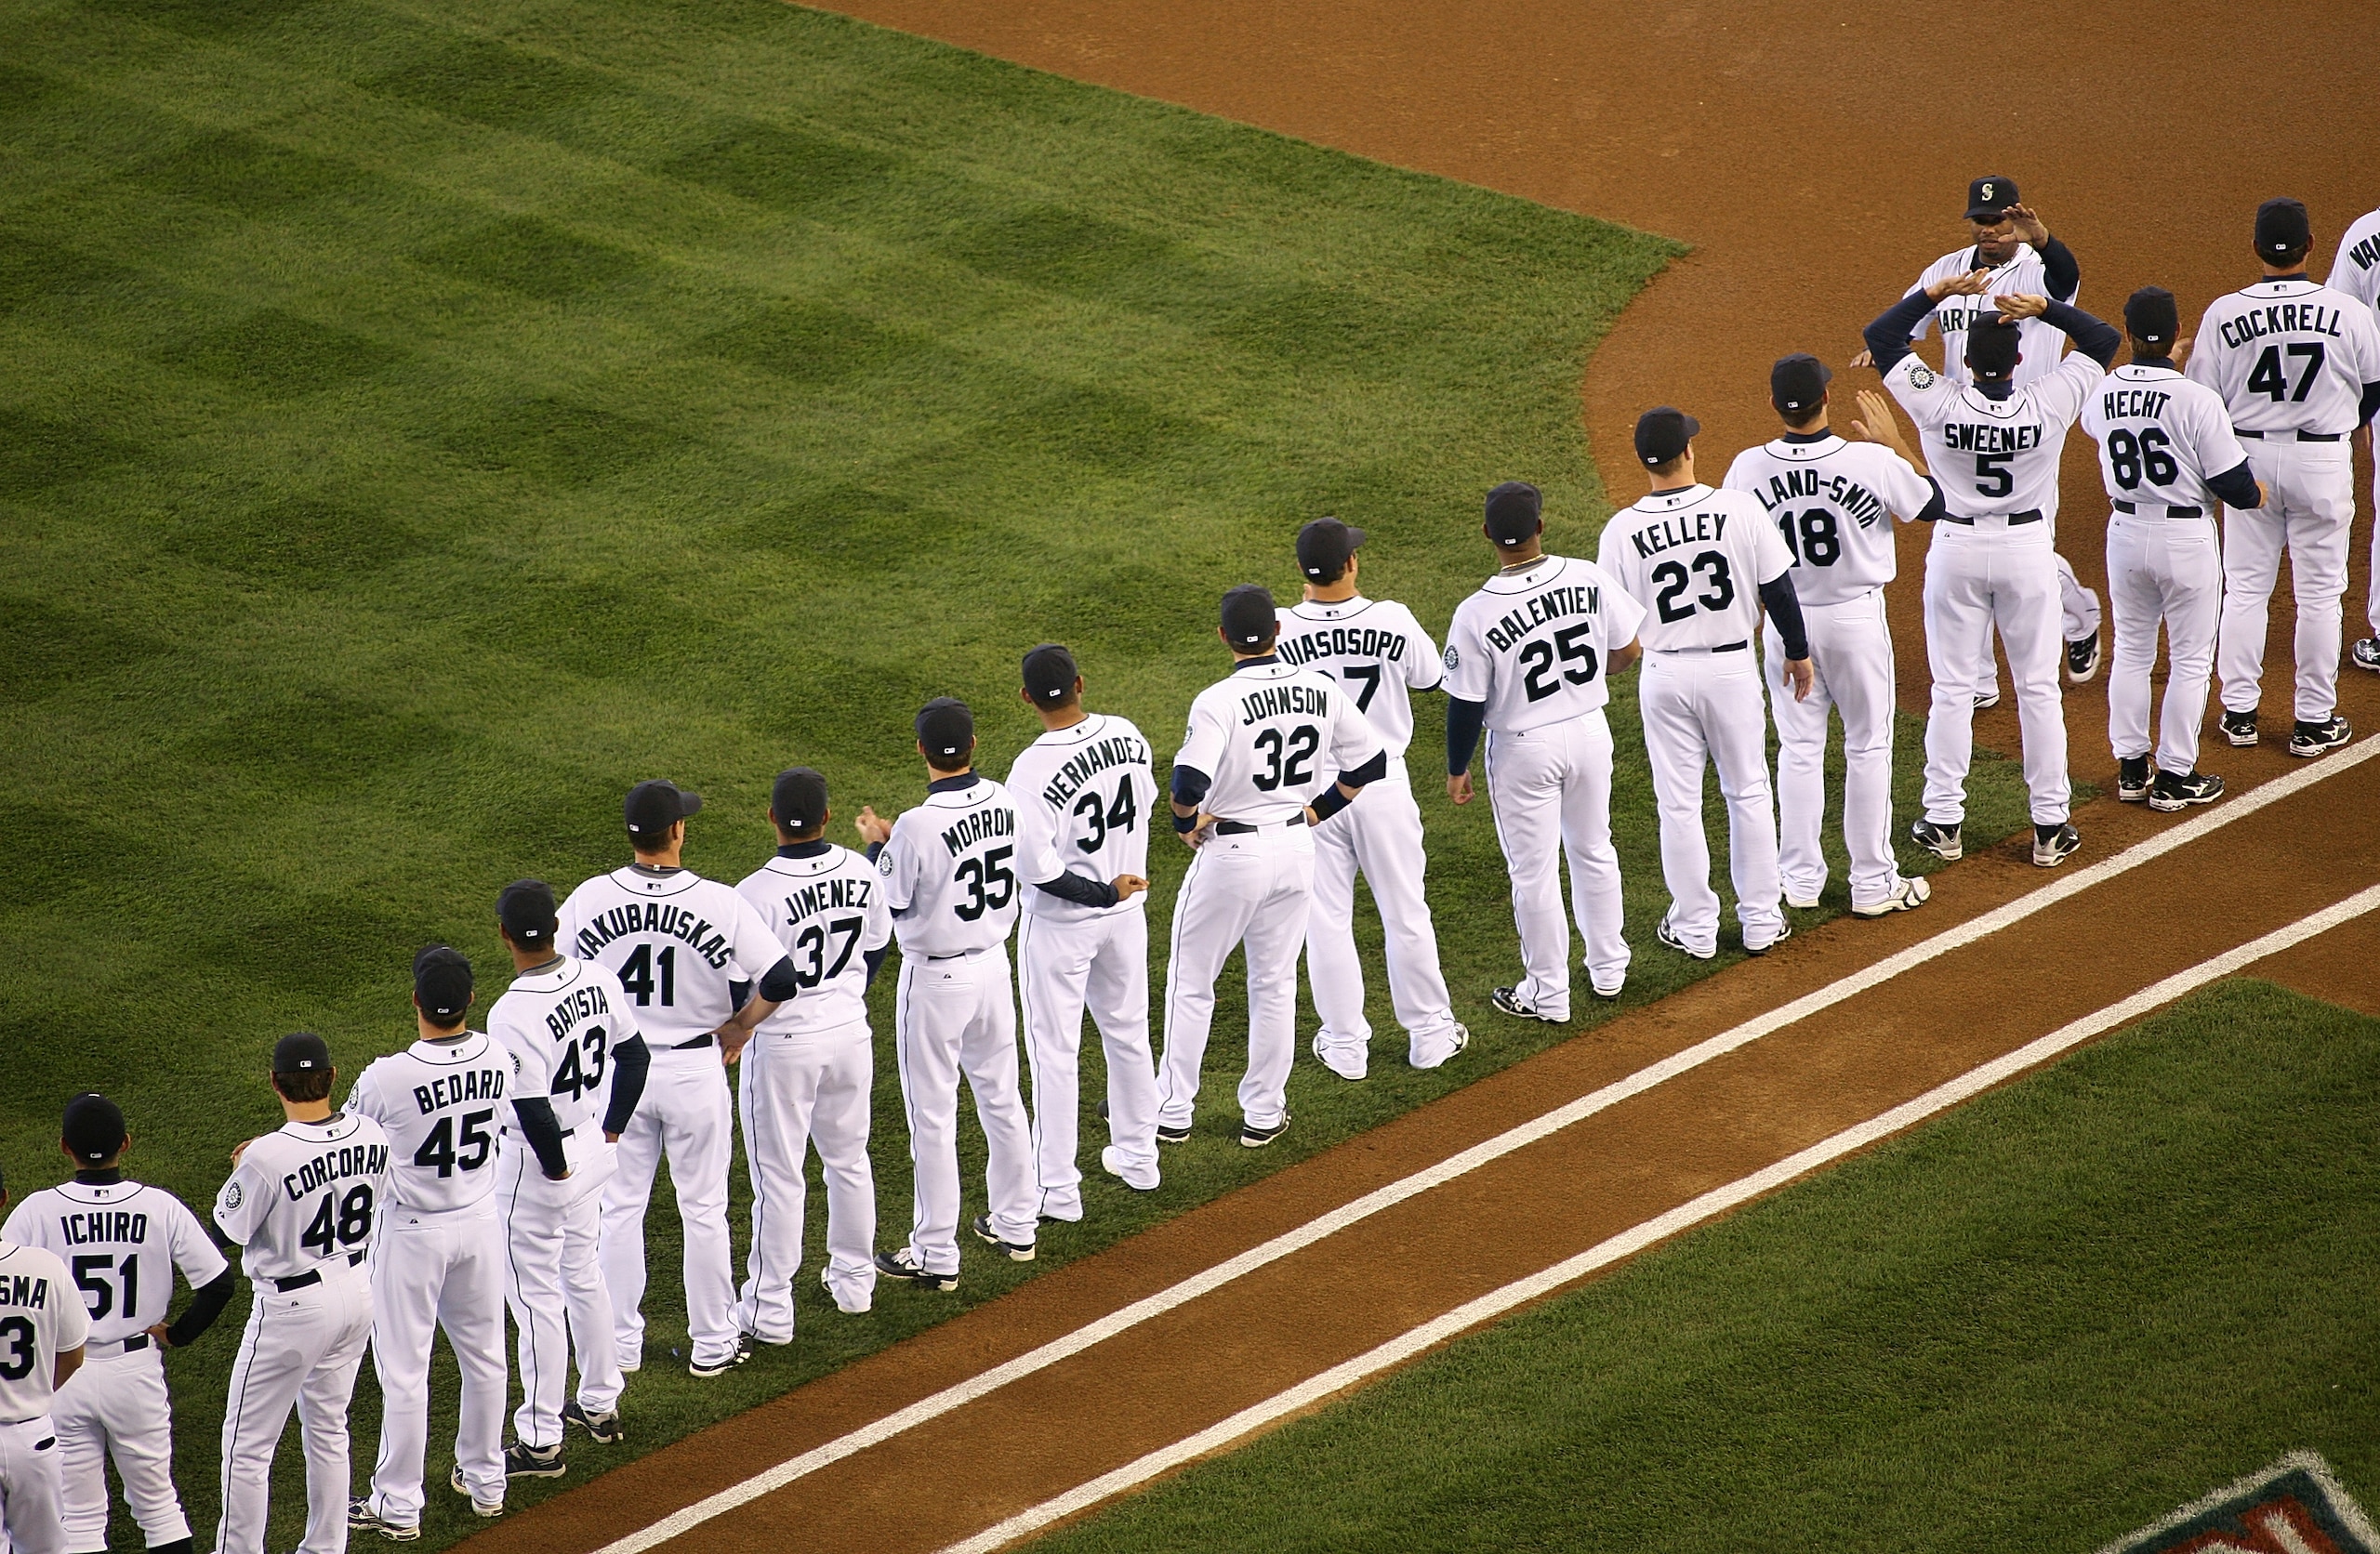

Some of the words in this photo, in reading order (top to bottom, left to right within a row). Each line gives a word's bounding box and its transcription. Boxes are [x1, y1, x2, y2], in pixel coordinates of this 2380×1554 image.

[2221, 304, 2341, 349] COCKRELL
[2247, 342, 2325, 402] 47
[2104, 390, 2172, 420] HECHT
[1944, 423, 2042, 452] SWEENEY
[2108, 428, 2179, 490] 86
[1976, 453, 2014, 497] 5
[1631, 513, 1726, 560] KELLEY
[1778, 508, 1841, 568] 18
[1651, 550, 1735, 625] 23
[1276, 628, 1406, 666] UIASOSOPO
[1486, 586, 1598, 653] BALENTIEN
[1315, 665, 1381, 715] 7
[1519, 621, 1598, 703] 25
[1241, 686, 1327, 726] JOHNSON
[1042, 736, 1146, 810] HERNANDEZ
[1252, 724, 1319, 792] 32
[940, 808, 1014, 858] MORROW
[1073, 772, 1136, 855] 34
[785, 878, 871, 926] JIMENEZ
[954, 843, 1014, 922] 35
[617, 943, 675, 1007] 41
[796, 915, 863, 989] 37
[545, 985, 609, 1043] BATISTA
[413, 1070, 504, 1115] BEDARD
[550, 1024, 606, 1103] 43
[284, 1144, 389, 1202] CORCORAN
[414, 1107, 494, 1179] 45
[60, 1212, 147, 1245] ICHIRO
[301, 1183, 373, 1256] 48
[72, 1253, 138, 1321] 51
